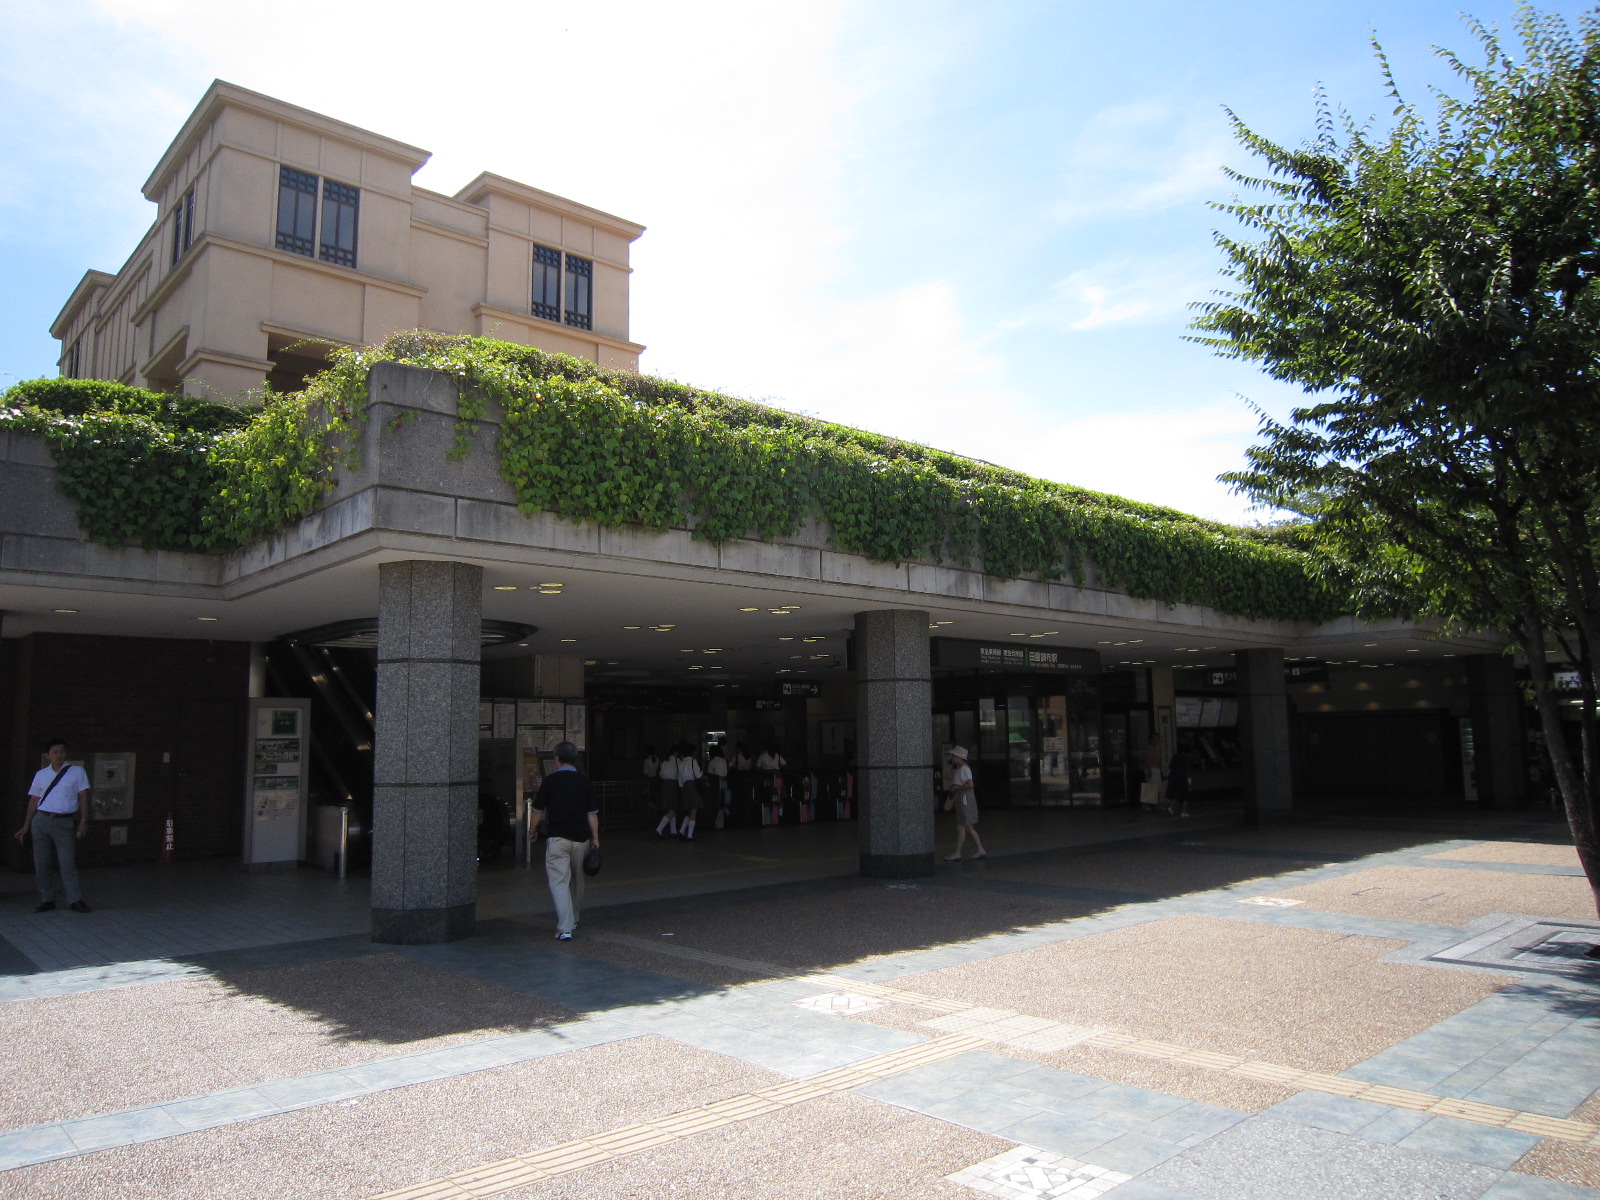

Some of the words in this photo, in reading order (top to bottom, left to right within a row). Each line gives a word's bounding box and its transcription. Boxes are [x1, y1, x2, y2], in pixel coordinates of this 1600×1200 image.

[1029, 651, 1058, 663] 田園調布駅
[166, 819, 174, 850] 駐車禁止
